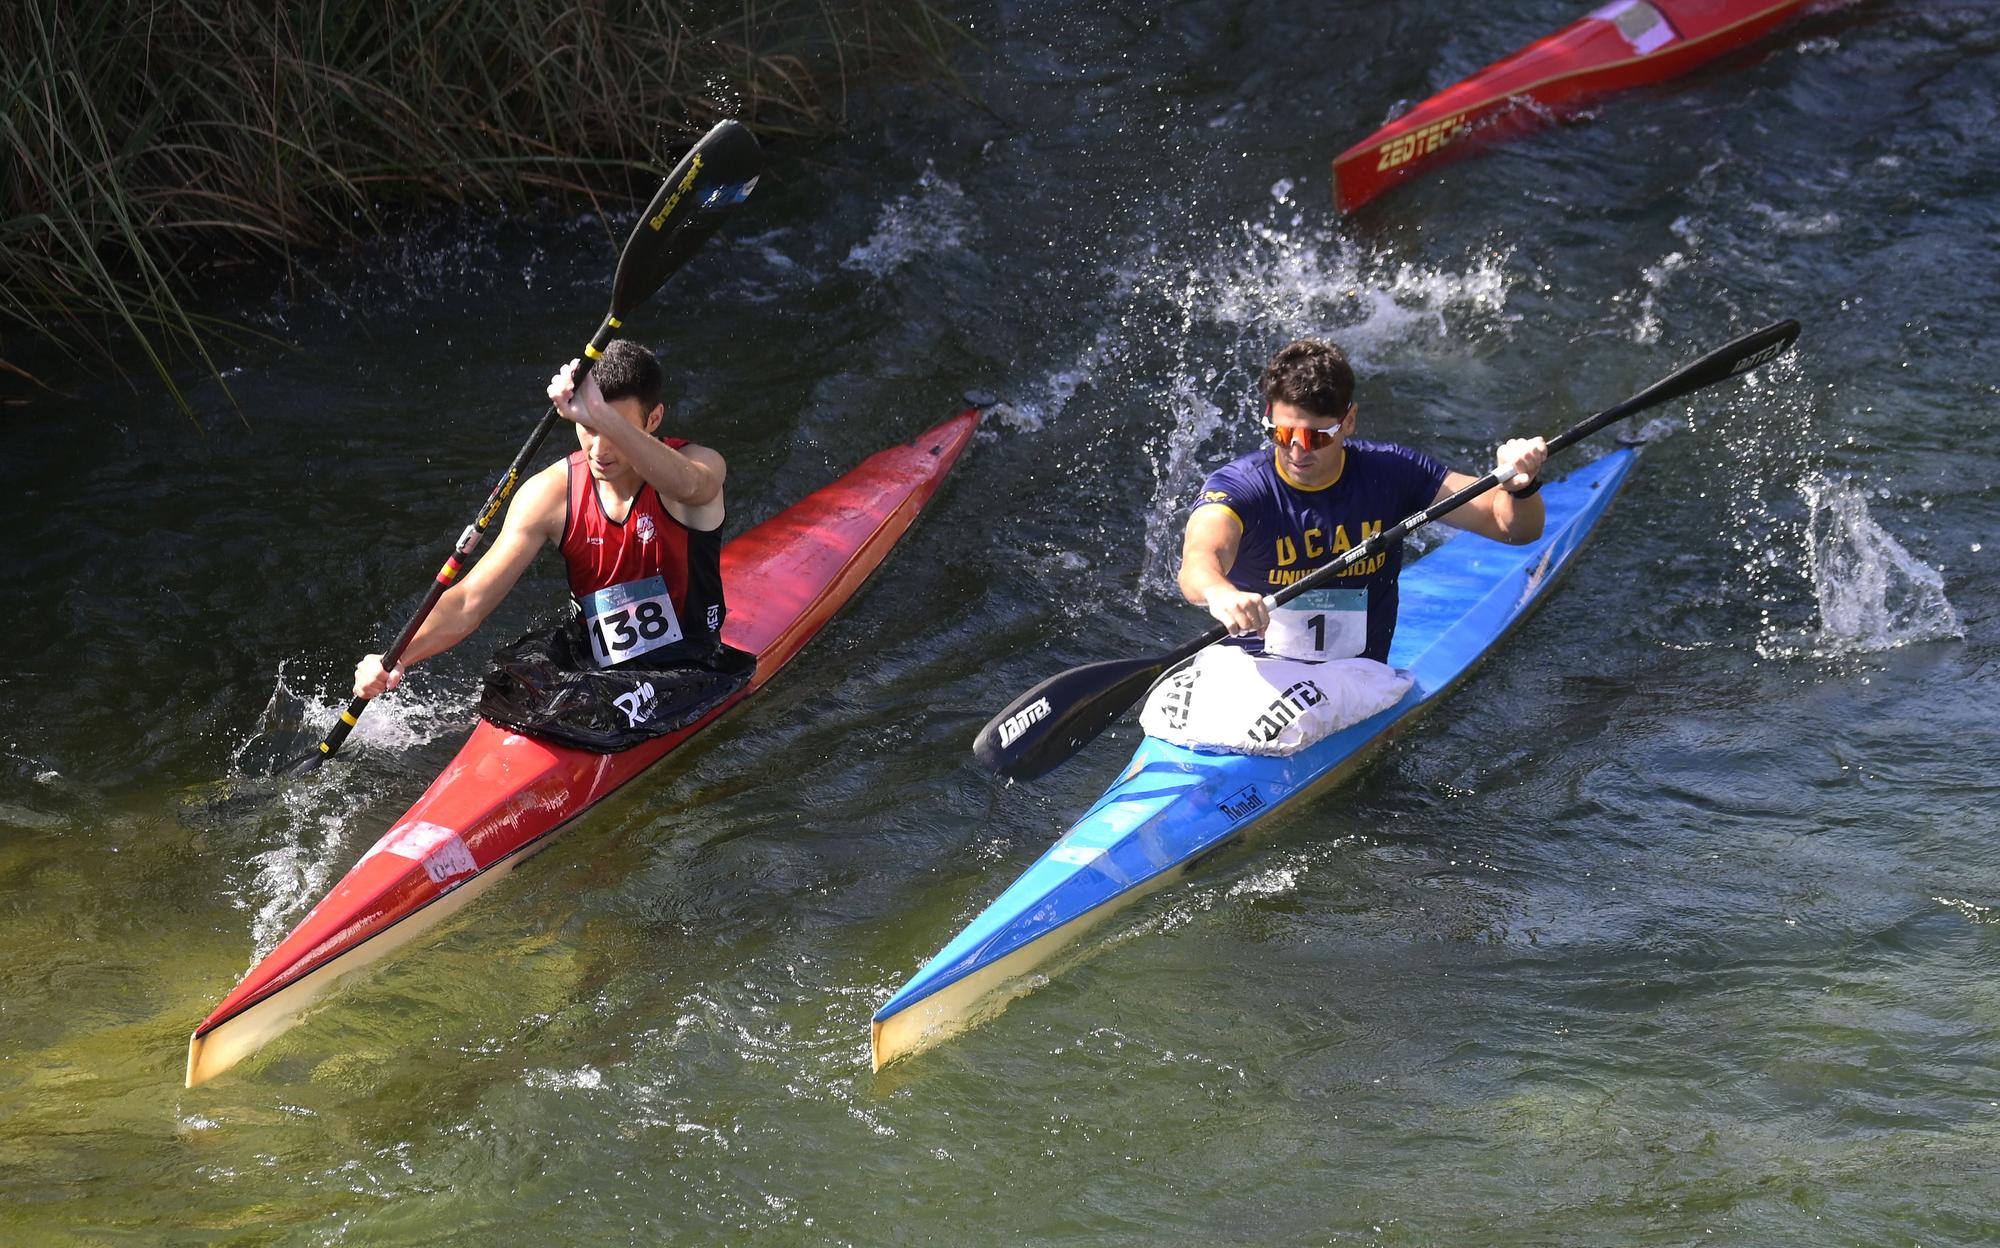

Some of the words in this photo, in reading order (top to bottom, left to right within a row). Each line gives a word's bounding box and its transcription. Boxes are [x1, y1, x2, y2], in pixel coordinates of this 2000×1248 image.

[1276, 519, 1382, 566] UCAM
[591, 602, 669, 658] 138
[1307, 613, 1326, 652] 1
